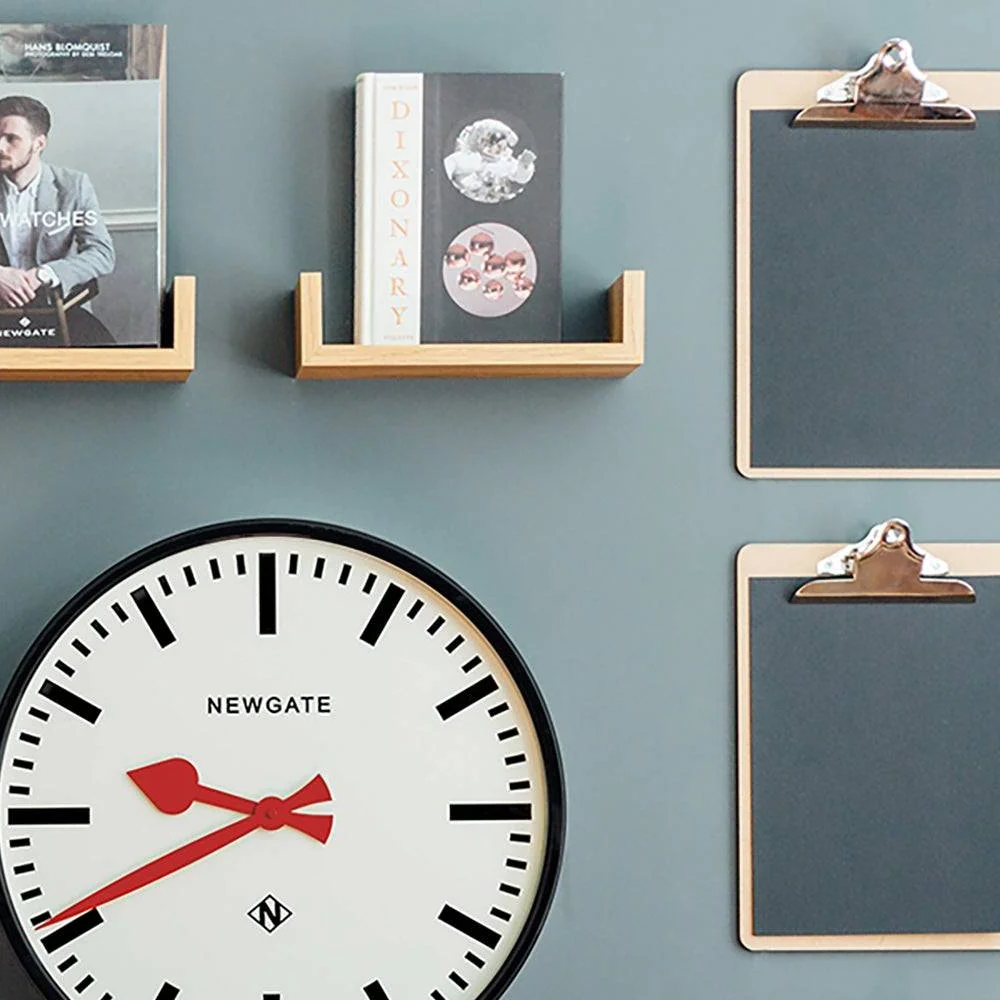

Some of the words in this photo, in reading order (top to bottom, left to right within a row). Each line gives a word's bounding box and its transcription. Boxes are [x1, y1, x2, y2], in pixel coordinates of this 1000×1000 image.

[24, 42, 53, 52] HANS
[55, 42, 111, 52] BLOMQUIST
[0, 209, 98, 229] WATCHES
[390, 100, 411, 326] DIXONARY
[207, 696, 331, 714] NEWGATE
